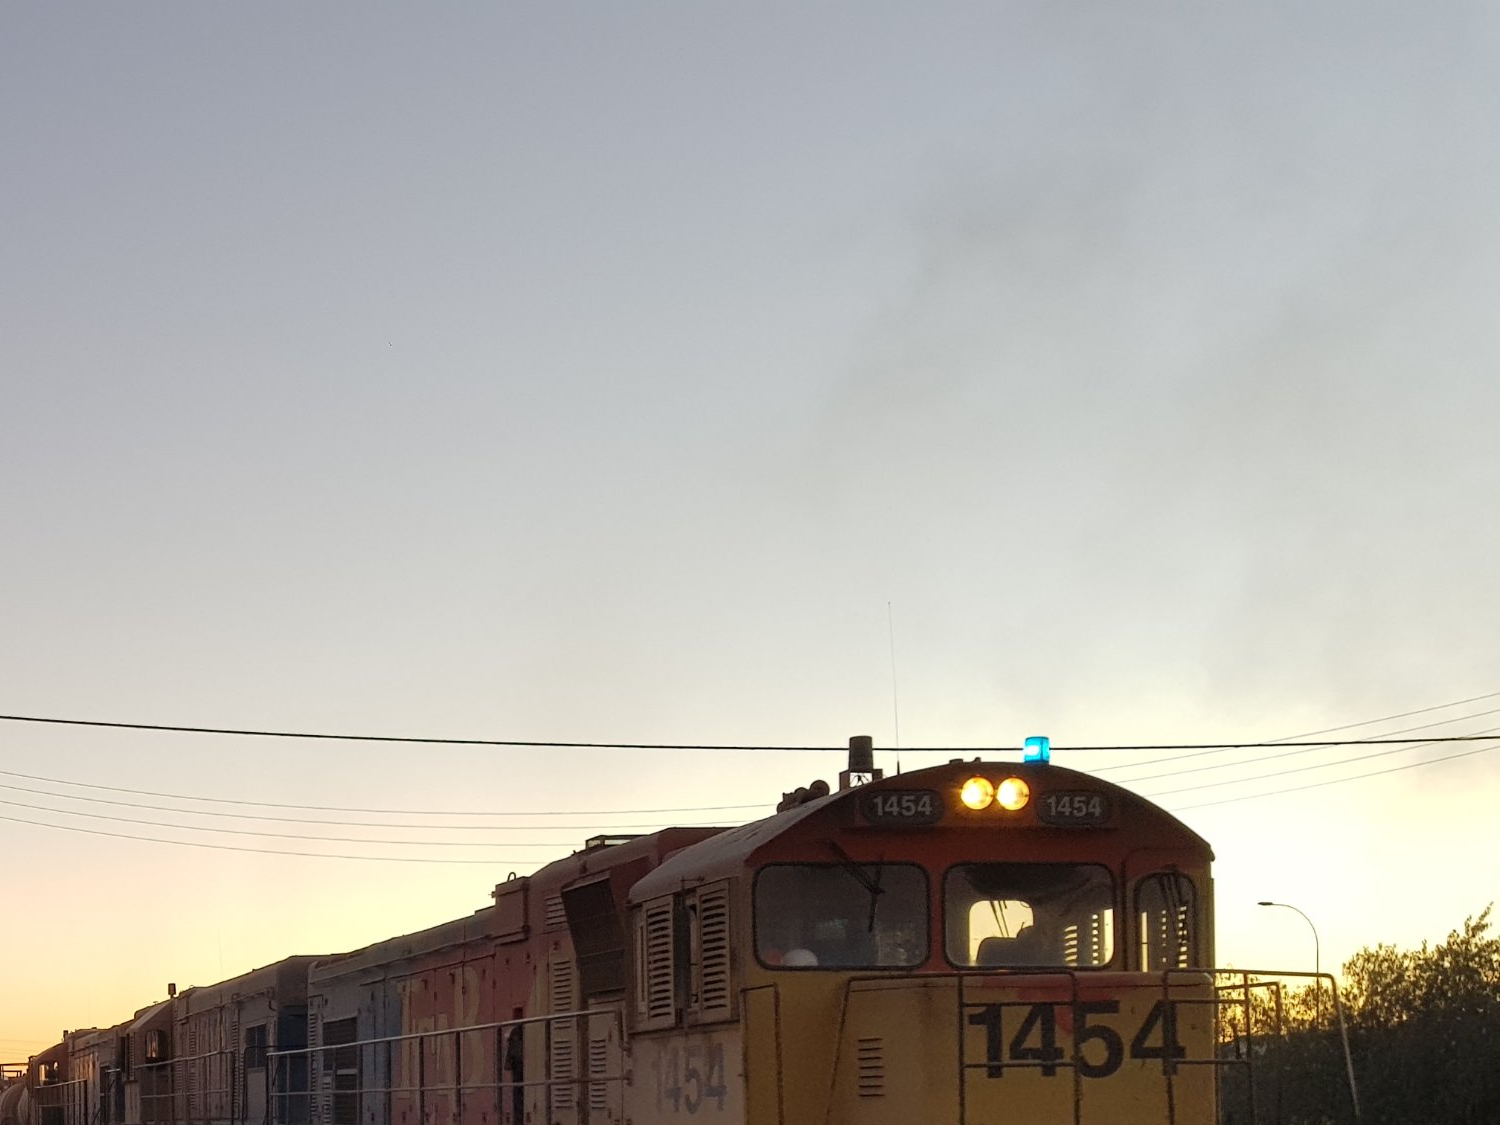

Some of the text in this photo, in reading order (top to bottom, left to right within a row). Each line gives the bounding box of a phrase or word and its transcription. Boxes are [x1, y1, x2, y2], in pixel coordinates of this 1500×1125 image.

[874, 795, 932, 817] 1454
[1049, 795, 1102, 818] 1454
[968, 999, 1187, 1079] 1454
[651, 1040, 727, 1115] 1454
